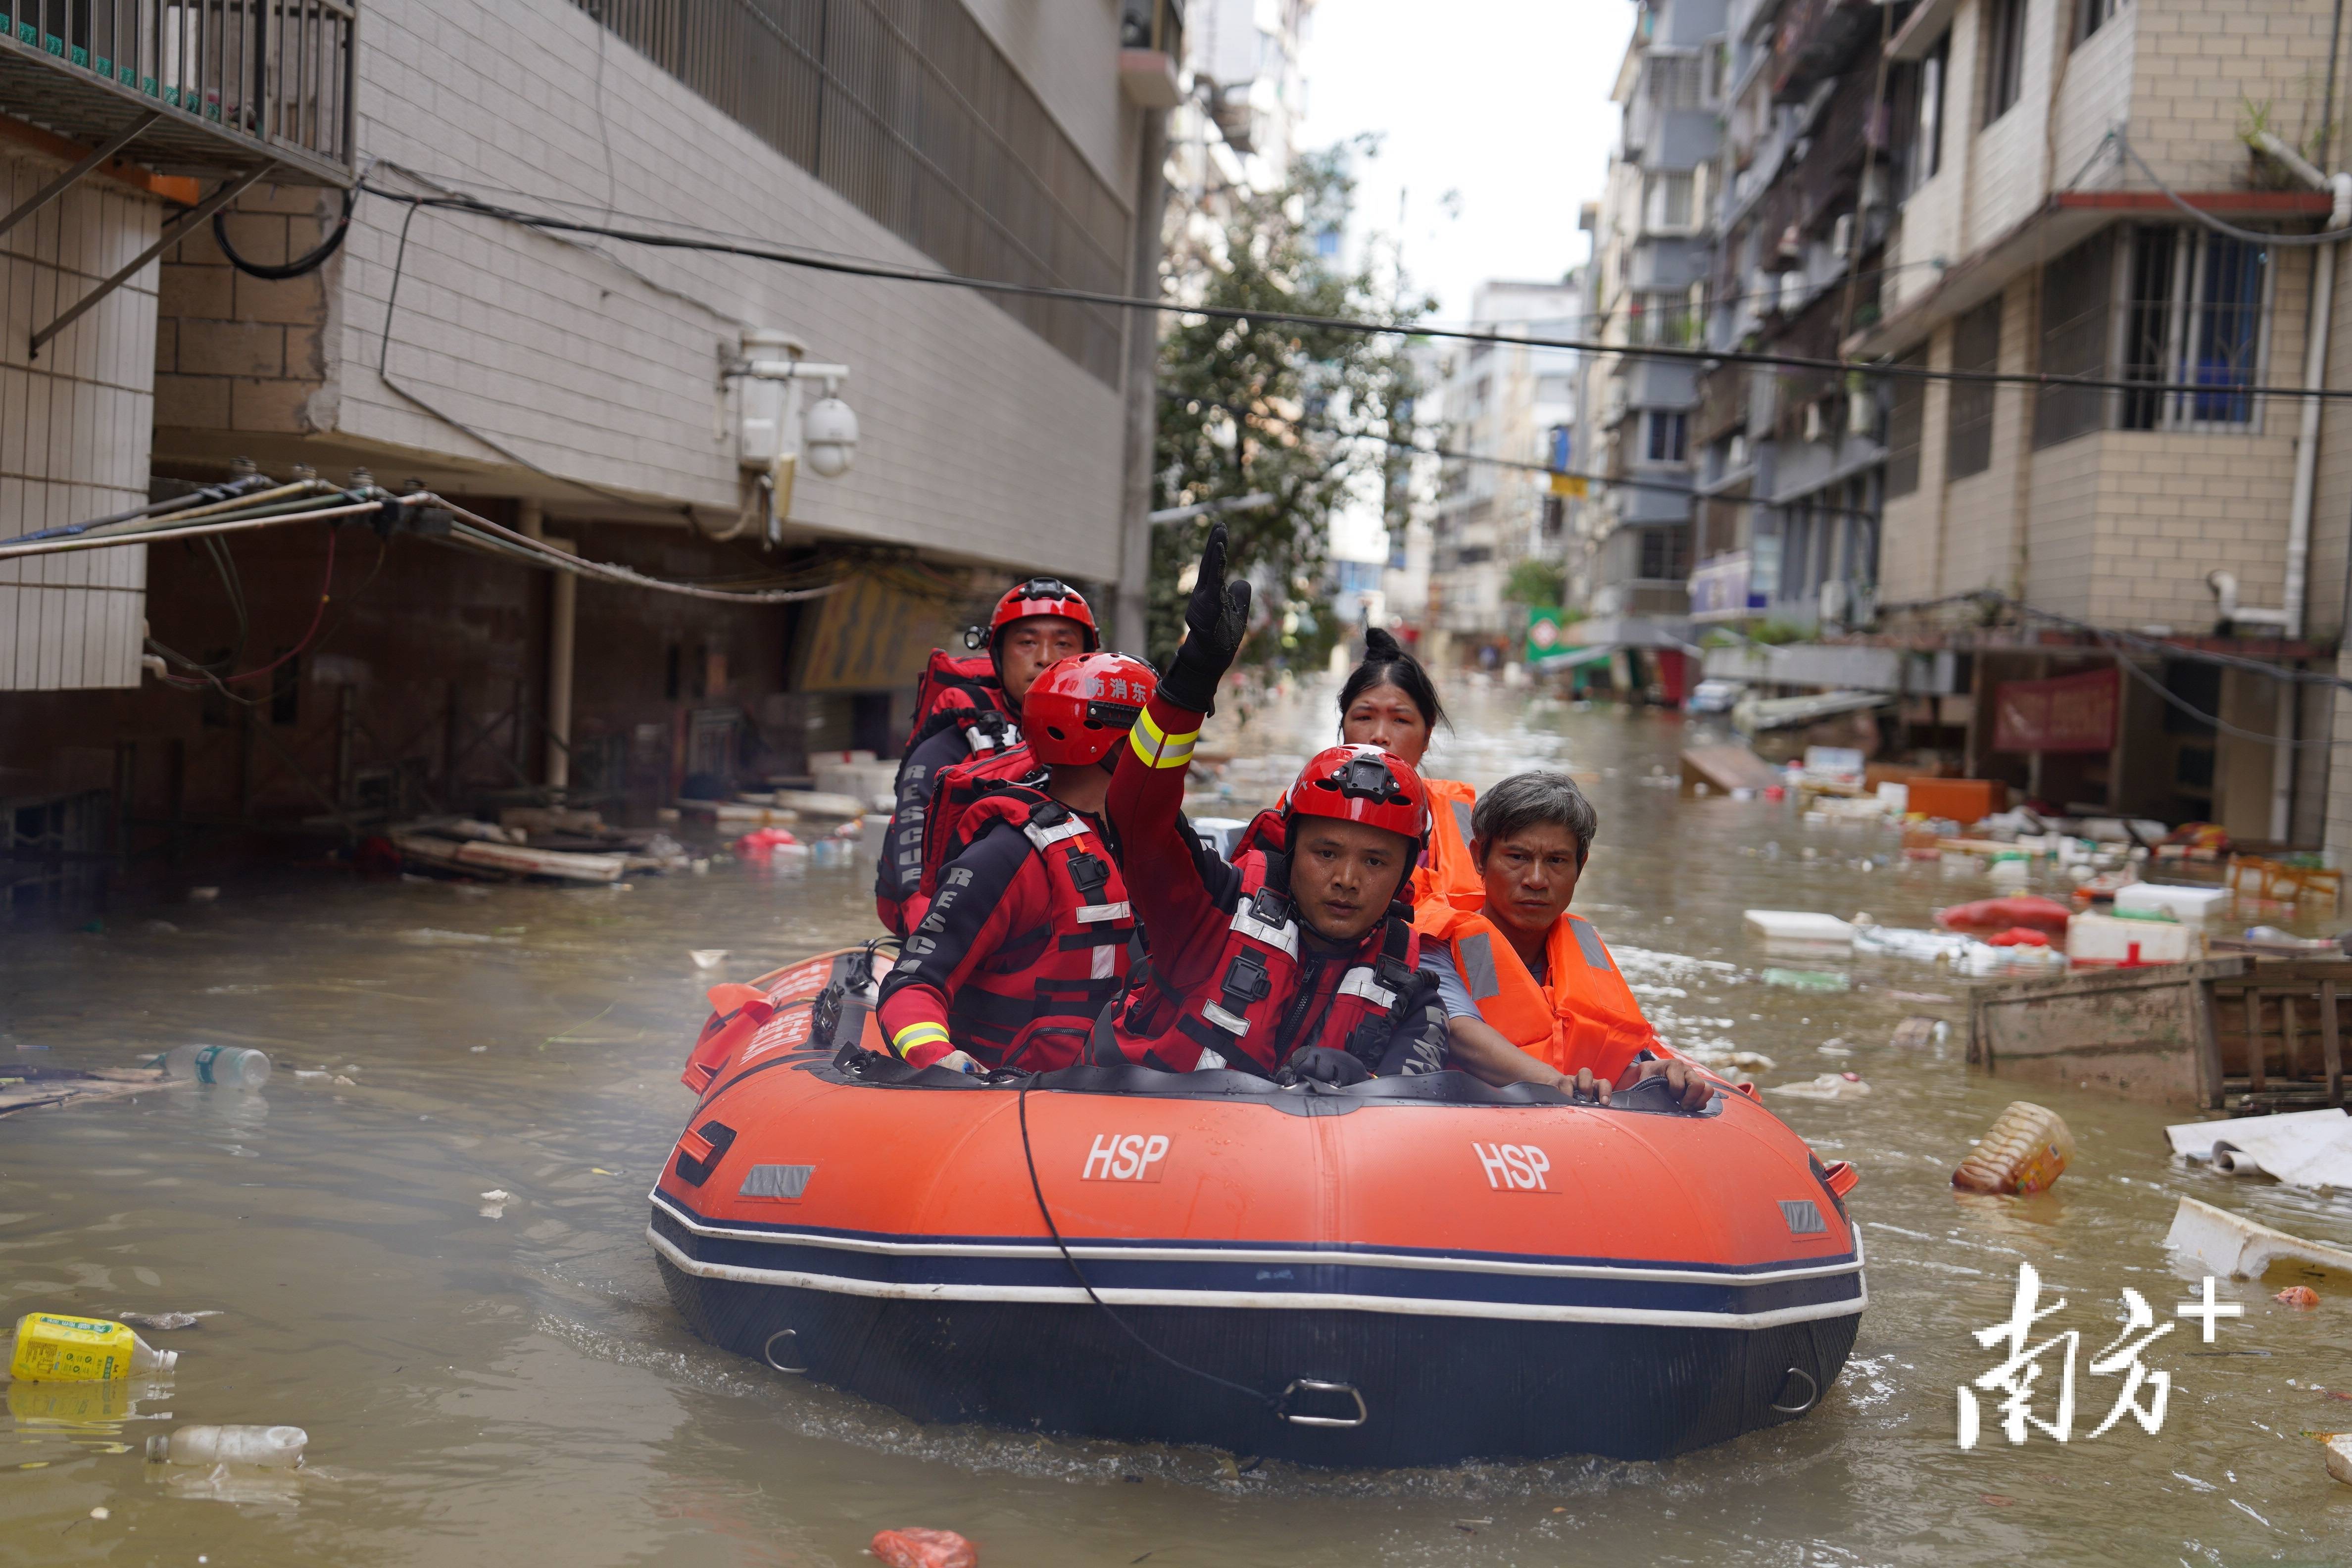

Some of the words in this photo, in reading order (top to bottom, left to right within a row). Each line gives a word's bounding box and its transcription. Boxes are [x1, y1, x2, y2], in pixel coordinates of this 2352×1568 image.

[1084, 677, 1157, 703] 防消东
[899, 765, 926, 883] RESCUE
[894, 868, 974, 983] RESCU
[1083, 1134, 1169, 1180] HSP
[1472, 1143, 1550, 1191] HSP
